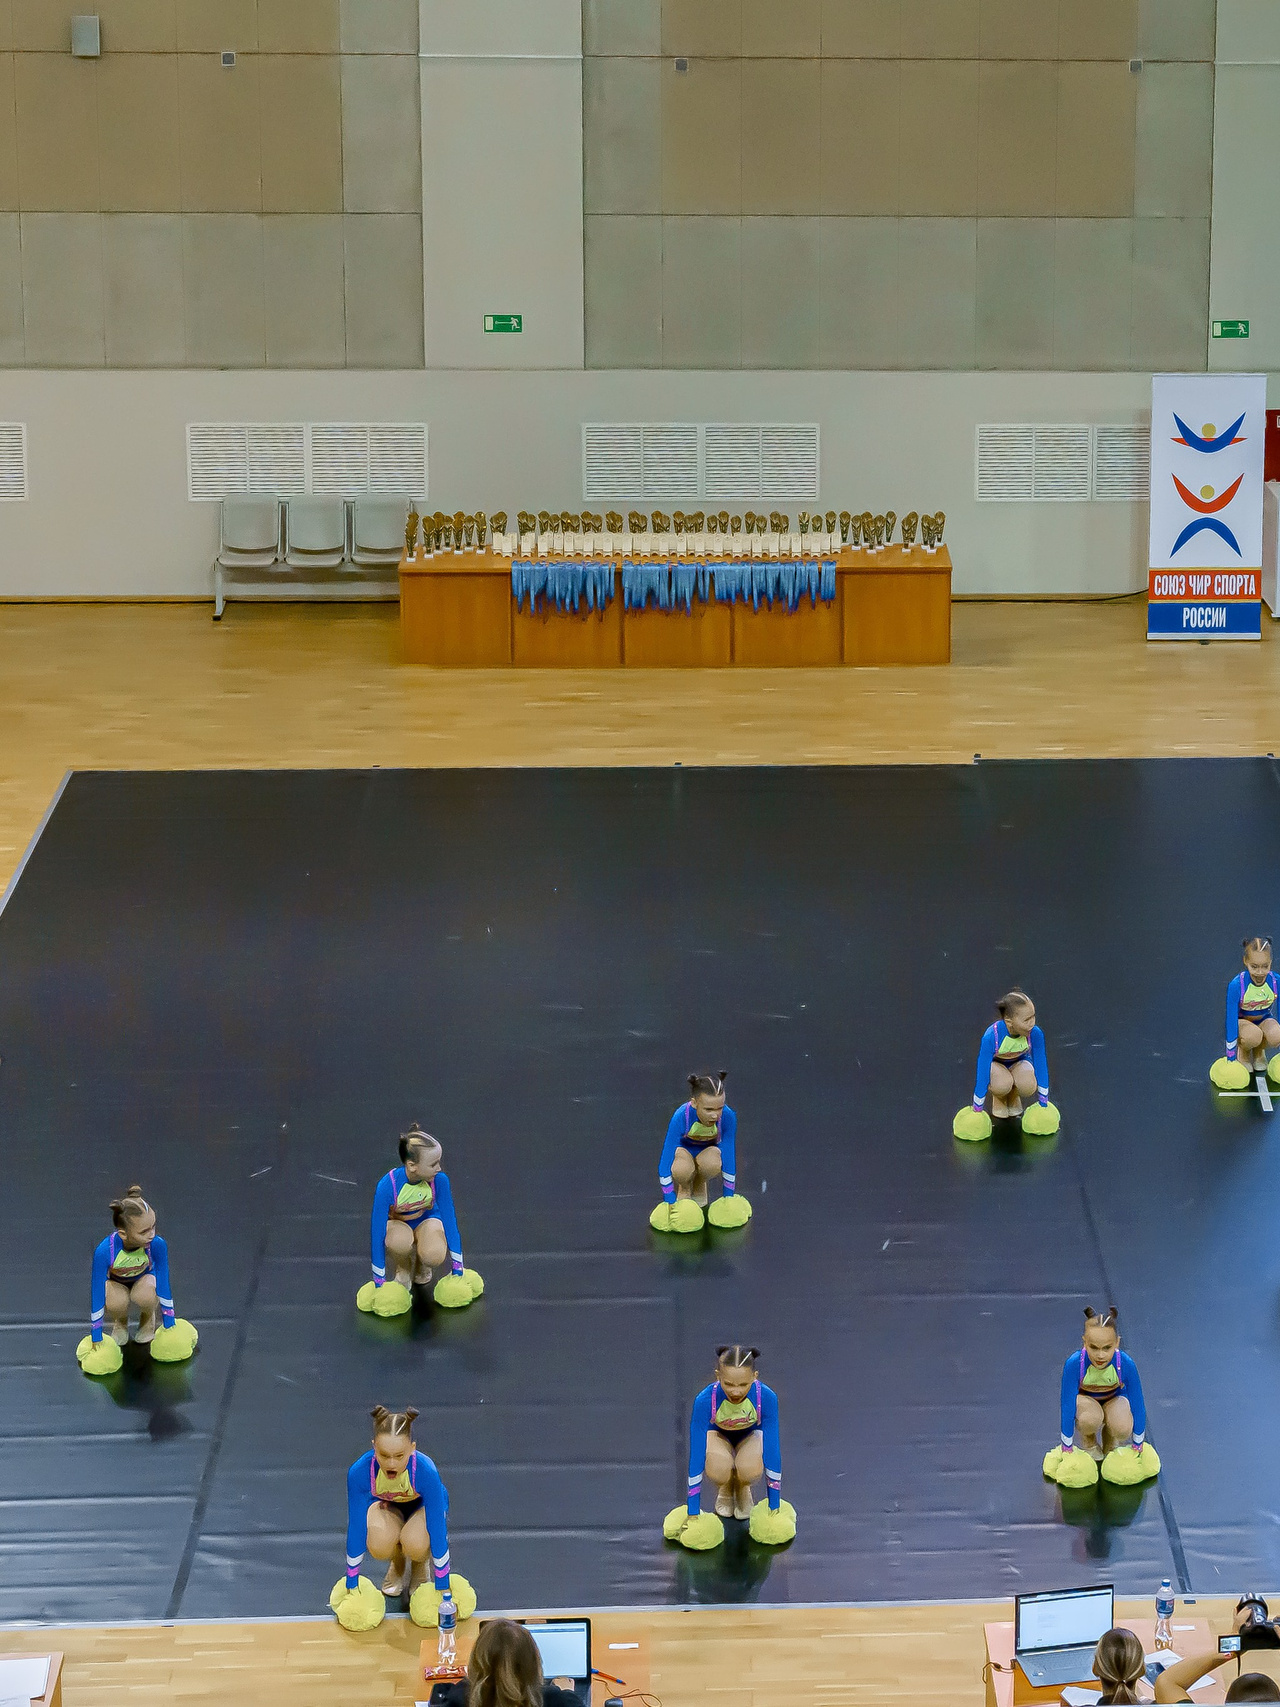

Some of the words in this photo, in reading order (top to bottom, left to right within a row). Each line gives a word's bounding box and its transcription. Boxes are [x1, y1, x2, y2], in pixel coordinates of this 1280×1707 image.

[1154, 574, 1186, 596] СОЮЗ
[1188, 574, 1211, 596] ЧИР
[1214, 574, 1256, 595] СПОРТА
[1182, 607, 1226, 628] РОССИИ
